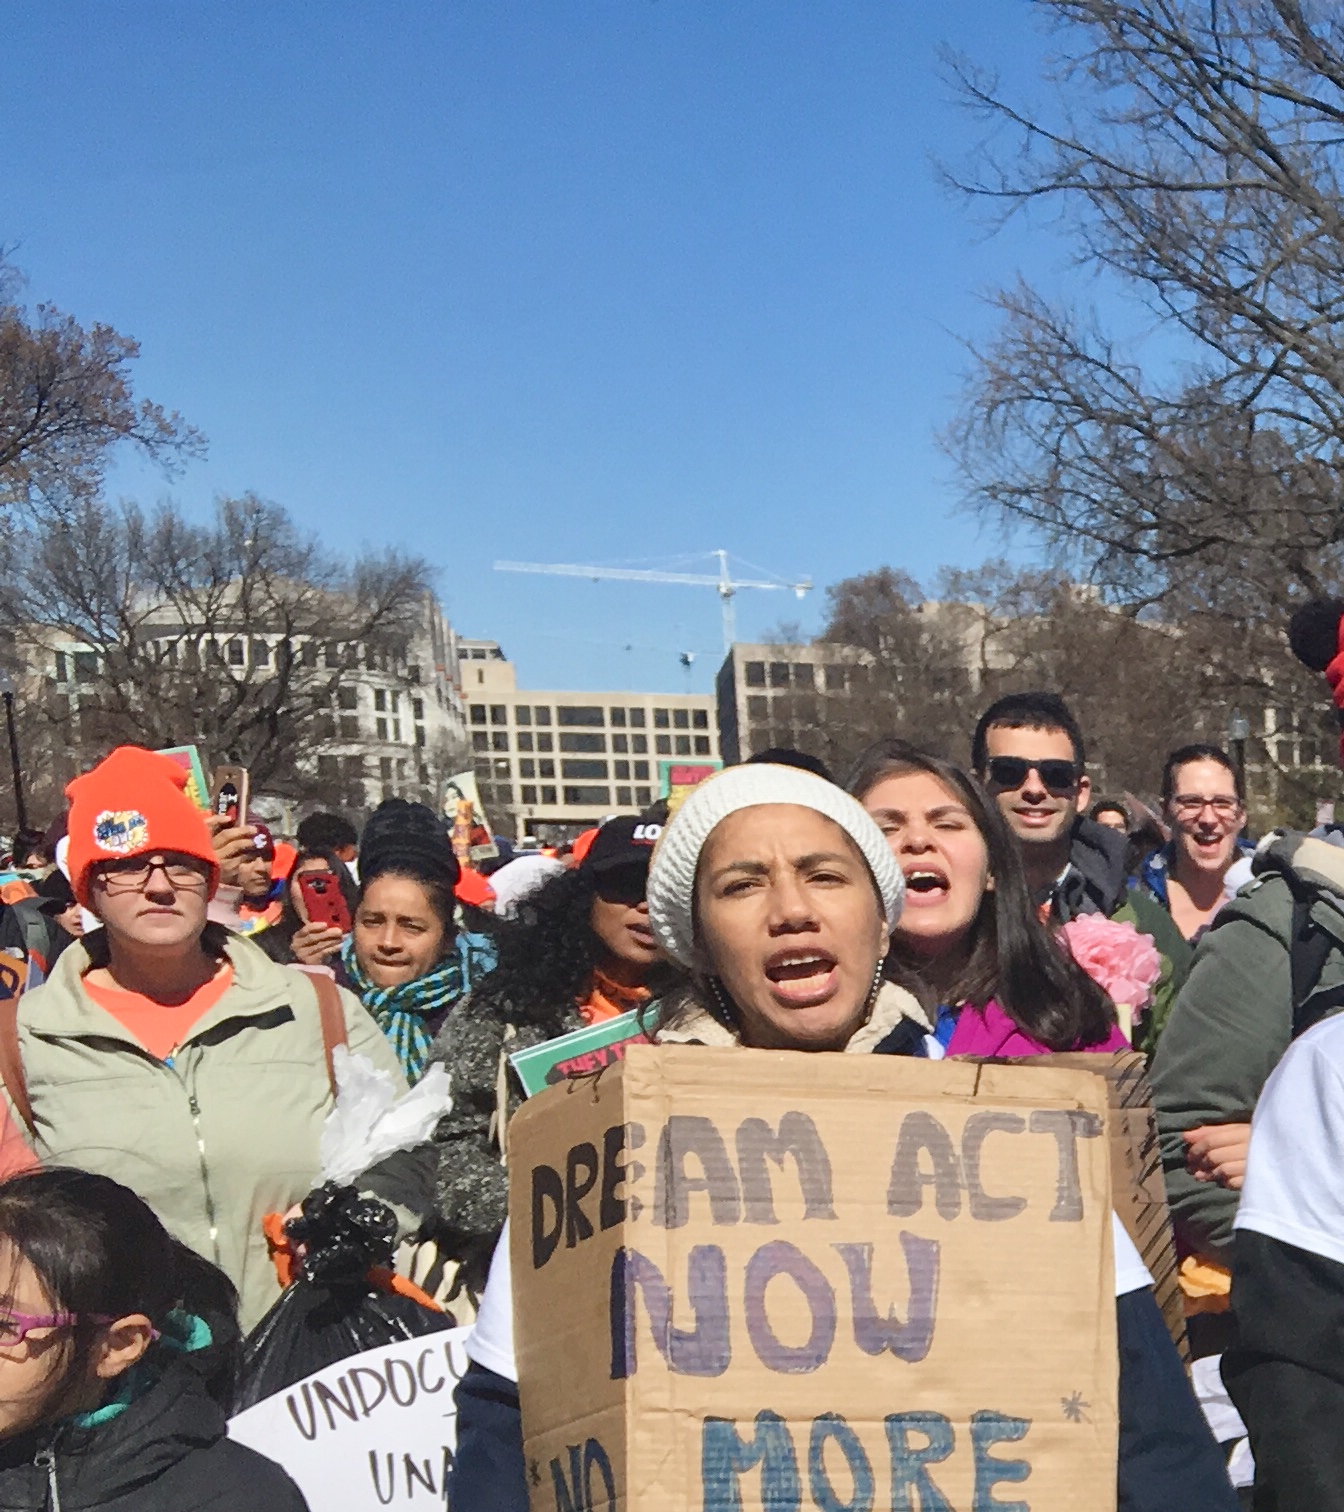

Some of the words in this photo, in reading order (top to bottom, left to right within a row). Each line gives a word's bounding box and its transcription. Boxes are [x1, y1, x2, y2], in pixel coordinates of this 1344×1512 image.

[633, 824, 663, 841] LO
[532, 1110, 838, 1269] DREAM
[887, 1110, 1104, 1222] ACT
[610, 1232, 941, 1380] NOW
[286, 1341, 466, 1440] UNDOCU
